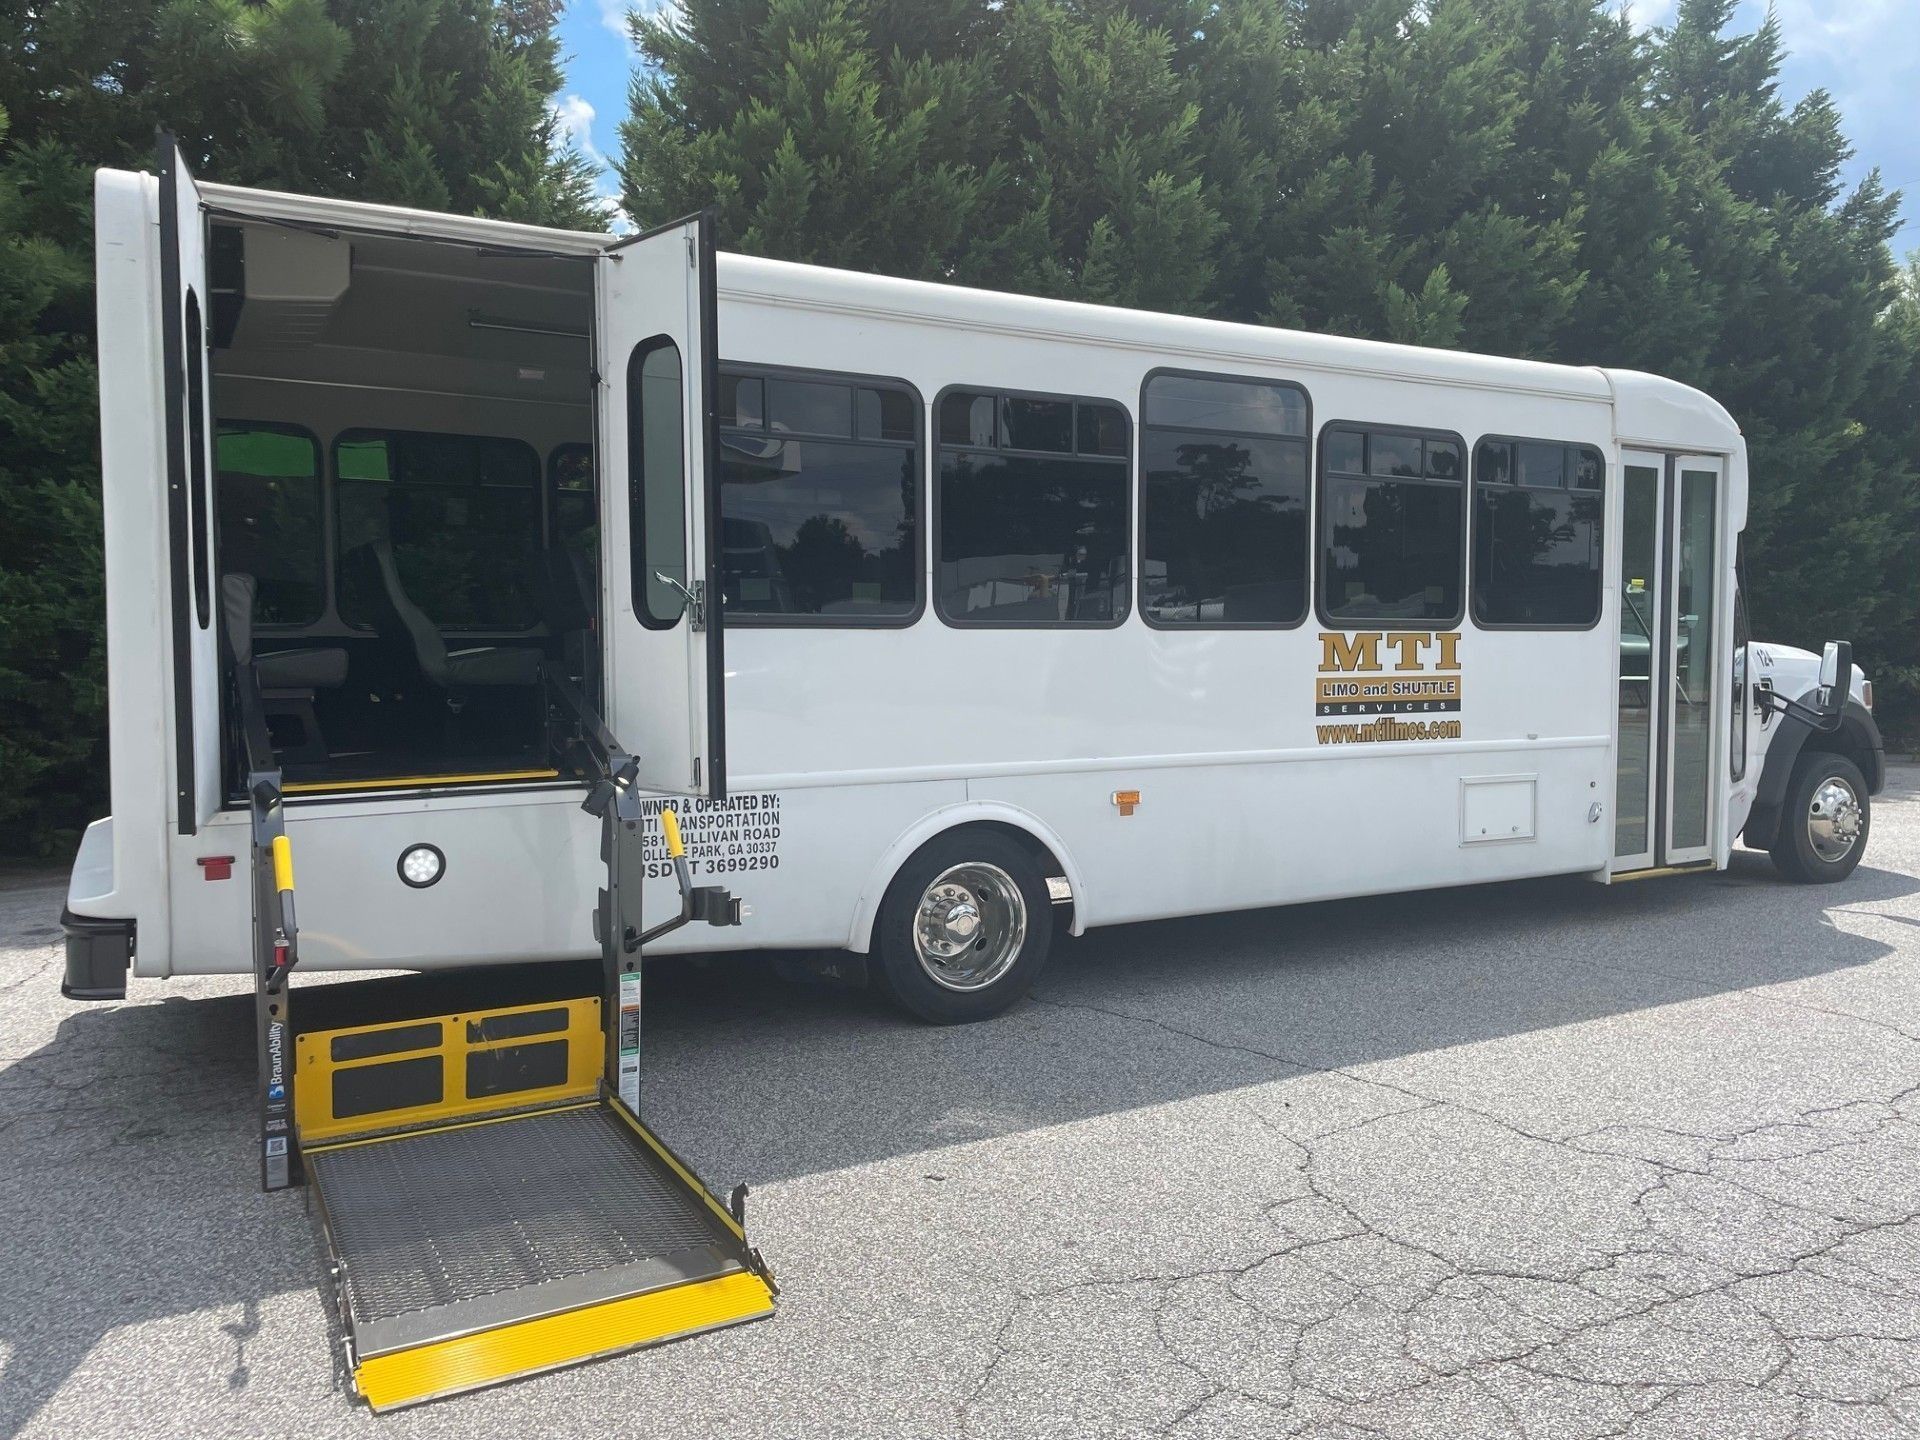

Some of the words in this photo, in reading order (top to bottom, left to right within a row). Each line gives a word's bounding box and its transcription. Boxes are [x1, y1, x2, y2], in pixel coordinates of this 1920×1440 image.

[1318, 632, 1461, 672] MTI
[1757, 649, 1774, 667] 124
[1323, 683, 1358, 697] LIMO
[1363, 682, 1388, 696] and
[1392, 681, 1455, 695] SHUTTLE
[1323, 702, 1446, 713] SERVICES
[1316, 717, 1461, 744] www.mtilimos.com
[641, 800, 679, 815] WNED
[683, 798, 692, 814] &
[696, 795, 758, 813] OPERATED
[762, 794, 780, 809] BY:
[676, 811, 780, 831] ANSPORTATION
[681, 830, 739, 845] ULLIVAN
[744, 827, 780, 841] ROAD
[643, 847, 688, 861] OLLEE
[691, 844, 725, 859] PARK,
[728, 843, 744, 856] GA
[746, 842, 777, 855] 30337
[705, 855, 780, 874] 3699290
[268, 1020, 283, 1085] BraunAbility
